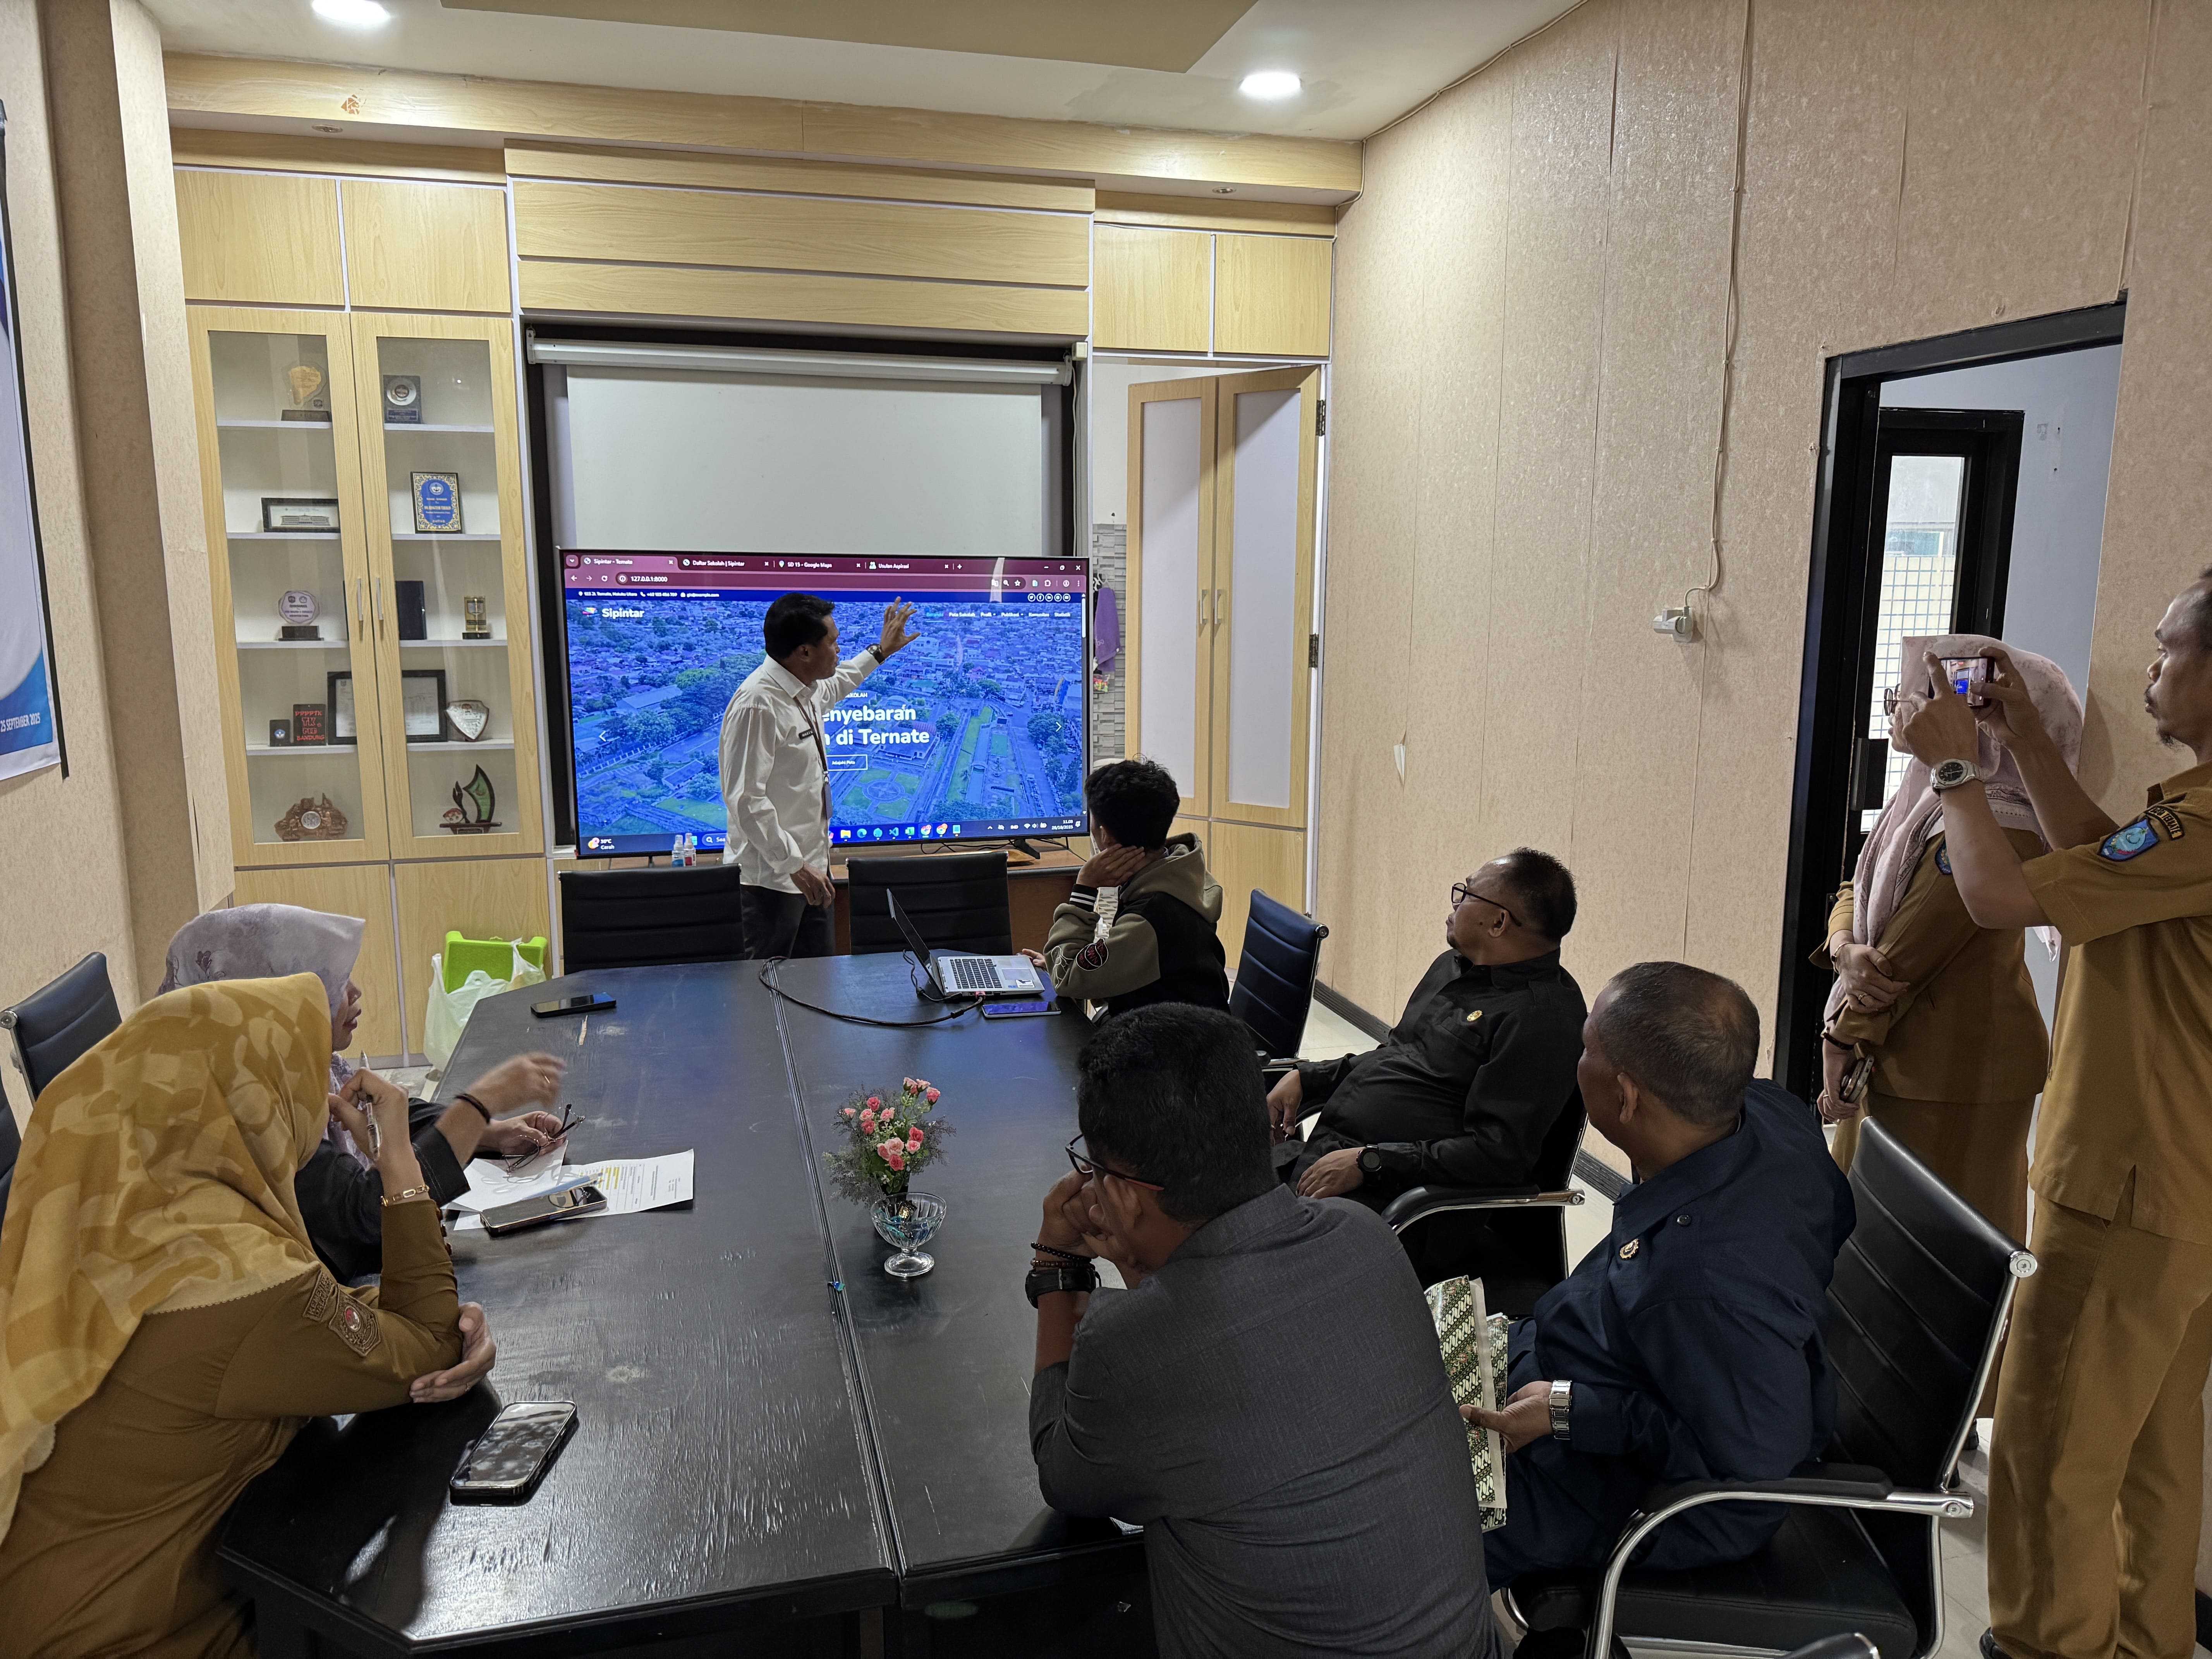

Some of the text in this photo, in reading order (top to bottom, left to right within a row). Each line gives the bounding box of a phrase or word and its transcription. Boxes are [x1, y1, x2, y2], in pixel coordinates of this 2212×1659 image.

[602, 608, 645, 619] Sipintar
[6, 715, 29, 731] SEPTEMBER
[29, 713, 40, 725] 2025
[822, 705, 916, 725] enyebaran
[836, 729, 854, 745] di
[858, 728, 929, 745] Ternate
